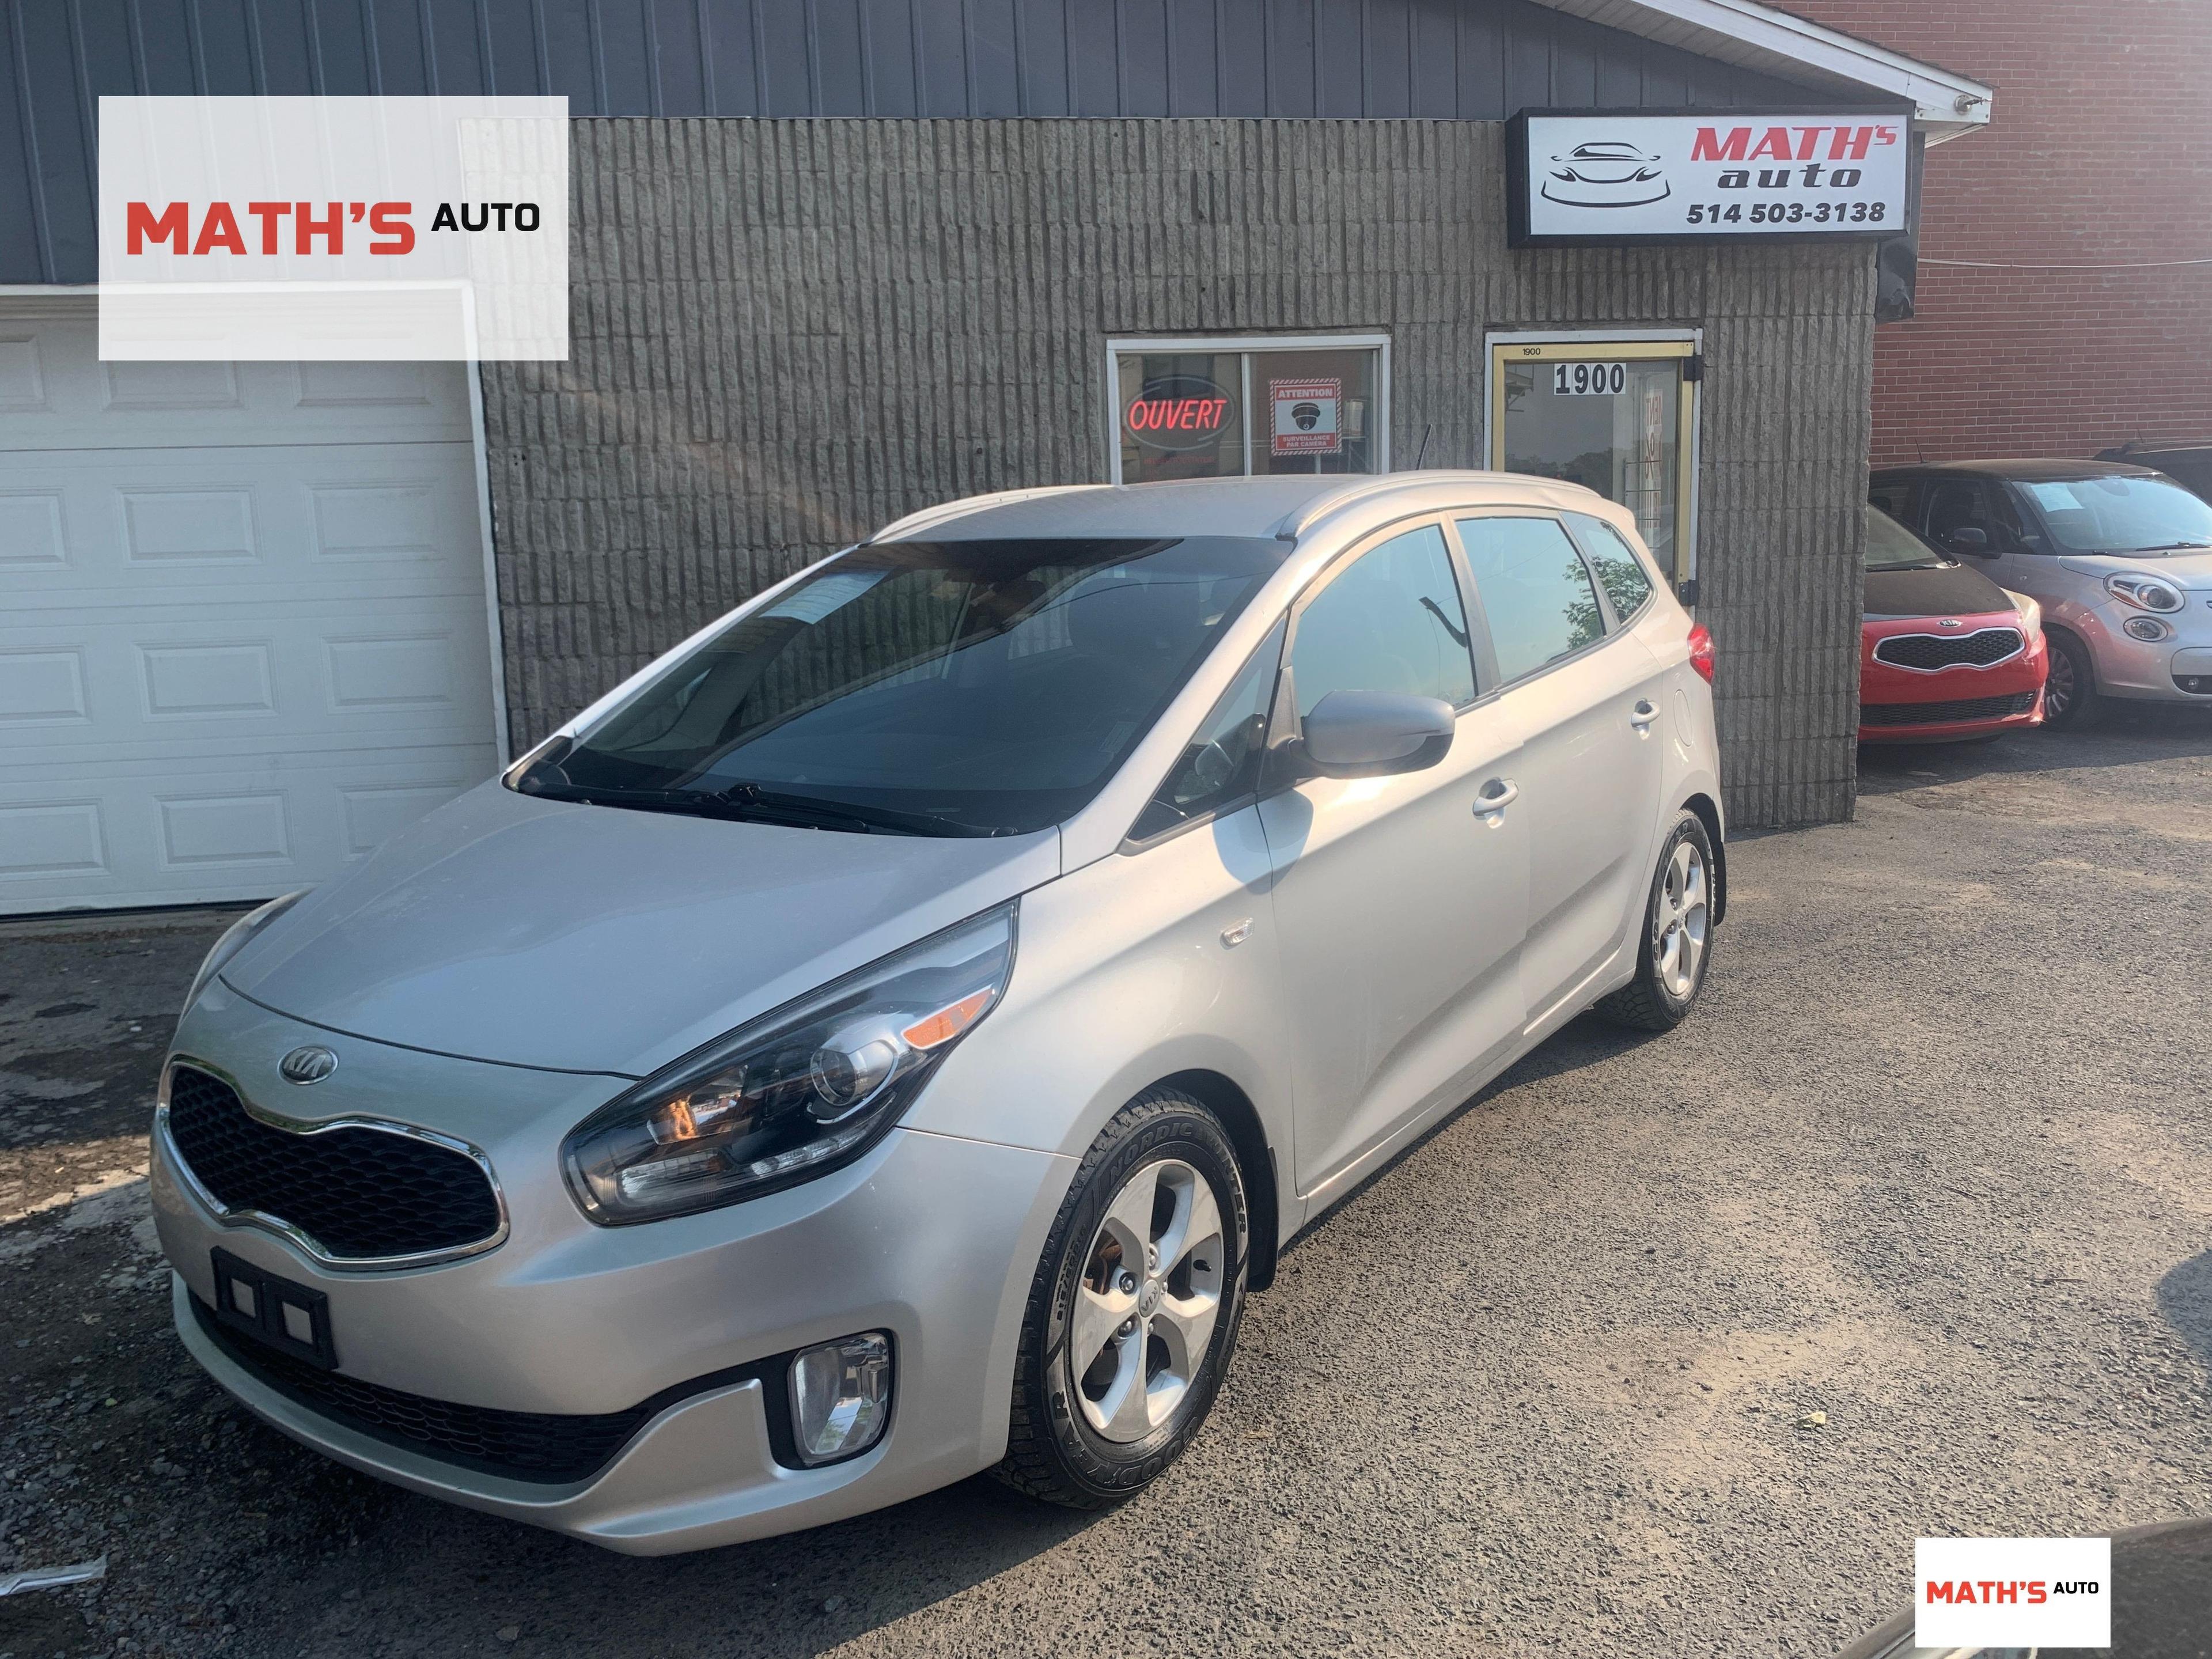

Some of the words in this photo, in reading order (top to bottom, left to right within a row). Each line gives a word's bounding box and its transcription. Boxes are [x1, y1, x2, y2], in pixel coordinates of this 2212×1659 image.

[1717, 163, 1861, 188] auto
[1686, 203, 1741, 224] 514
[1748, 202, 1886, 224] 503-3138
[1278, 388, 1333, 398] ATTENTION
[1556, 364, 1624, 394] 1900
[1128, 400, 1228, 430] OUVERT
[283, 1049, 327, 1078] KIA
[1109, 1122, 1194, 1187] NORDIC
[1141, 1286, 1158, 1312] KIA
[1052, 1390, 1200, 1486] GOODYEAR
